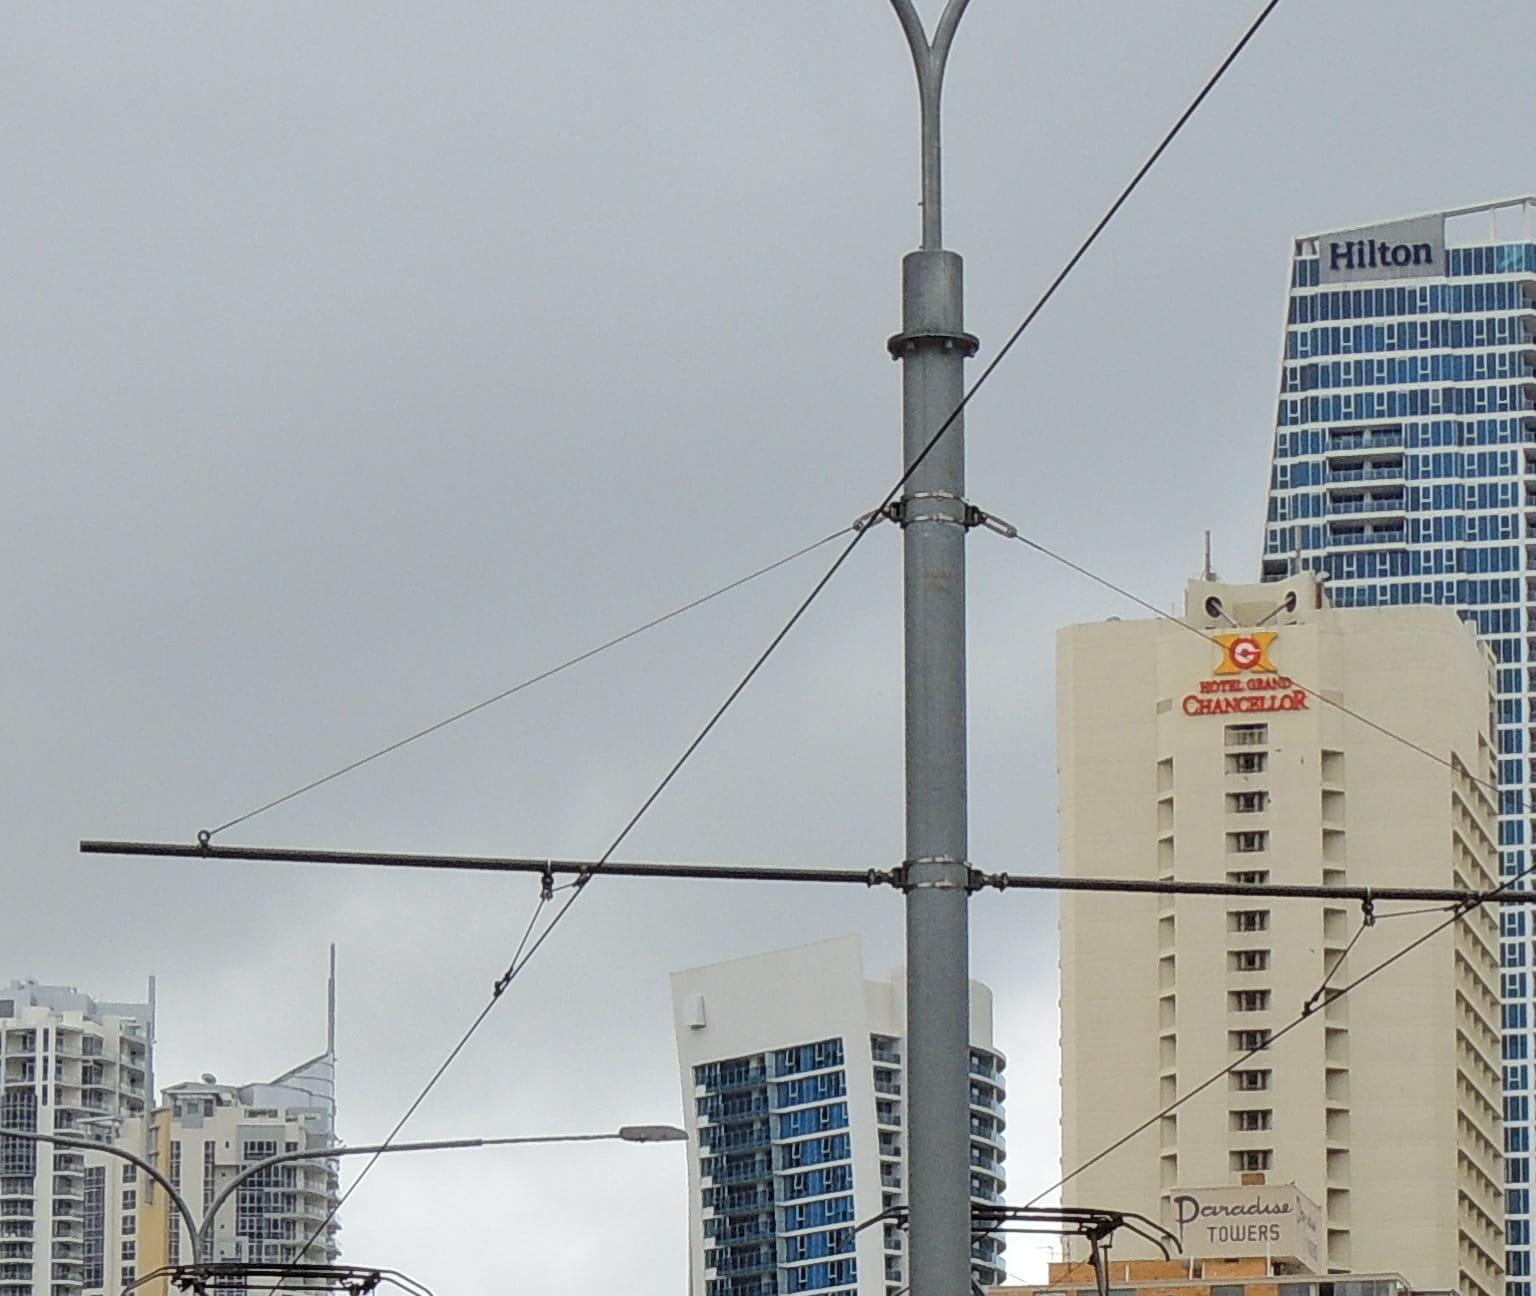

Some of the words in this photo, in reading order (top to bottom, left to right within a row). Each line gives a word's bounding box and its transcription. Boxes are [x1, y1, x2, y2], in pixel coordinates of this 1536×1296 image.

[1329, 239, 1433, 271] Hilton
[1200, 679, 1244, 694] HOTEL
[1246, 676, 1293, 691] GRAND
[1182, 690, 1309, 716] CHANCELLOR
[1173, 1195, 1293, 1242] Paradise
[1207, 1224, 1280, 1243] TOWERS
